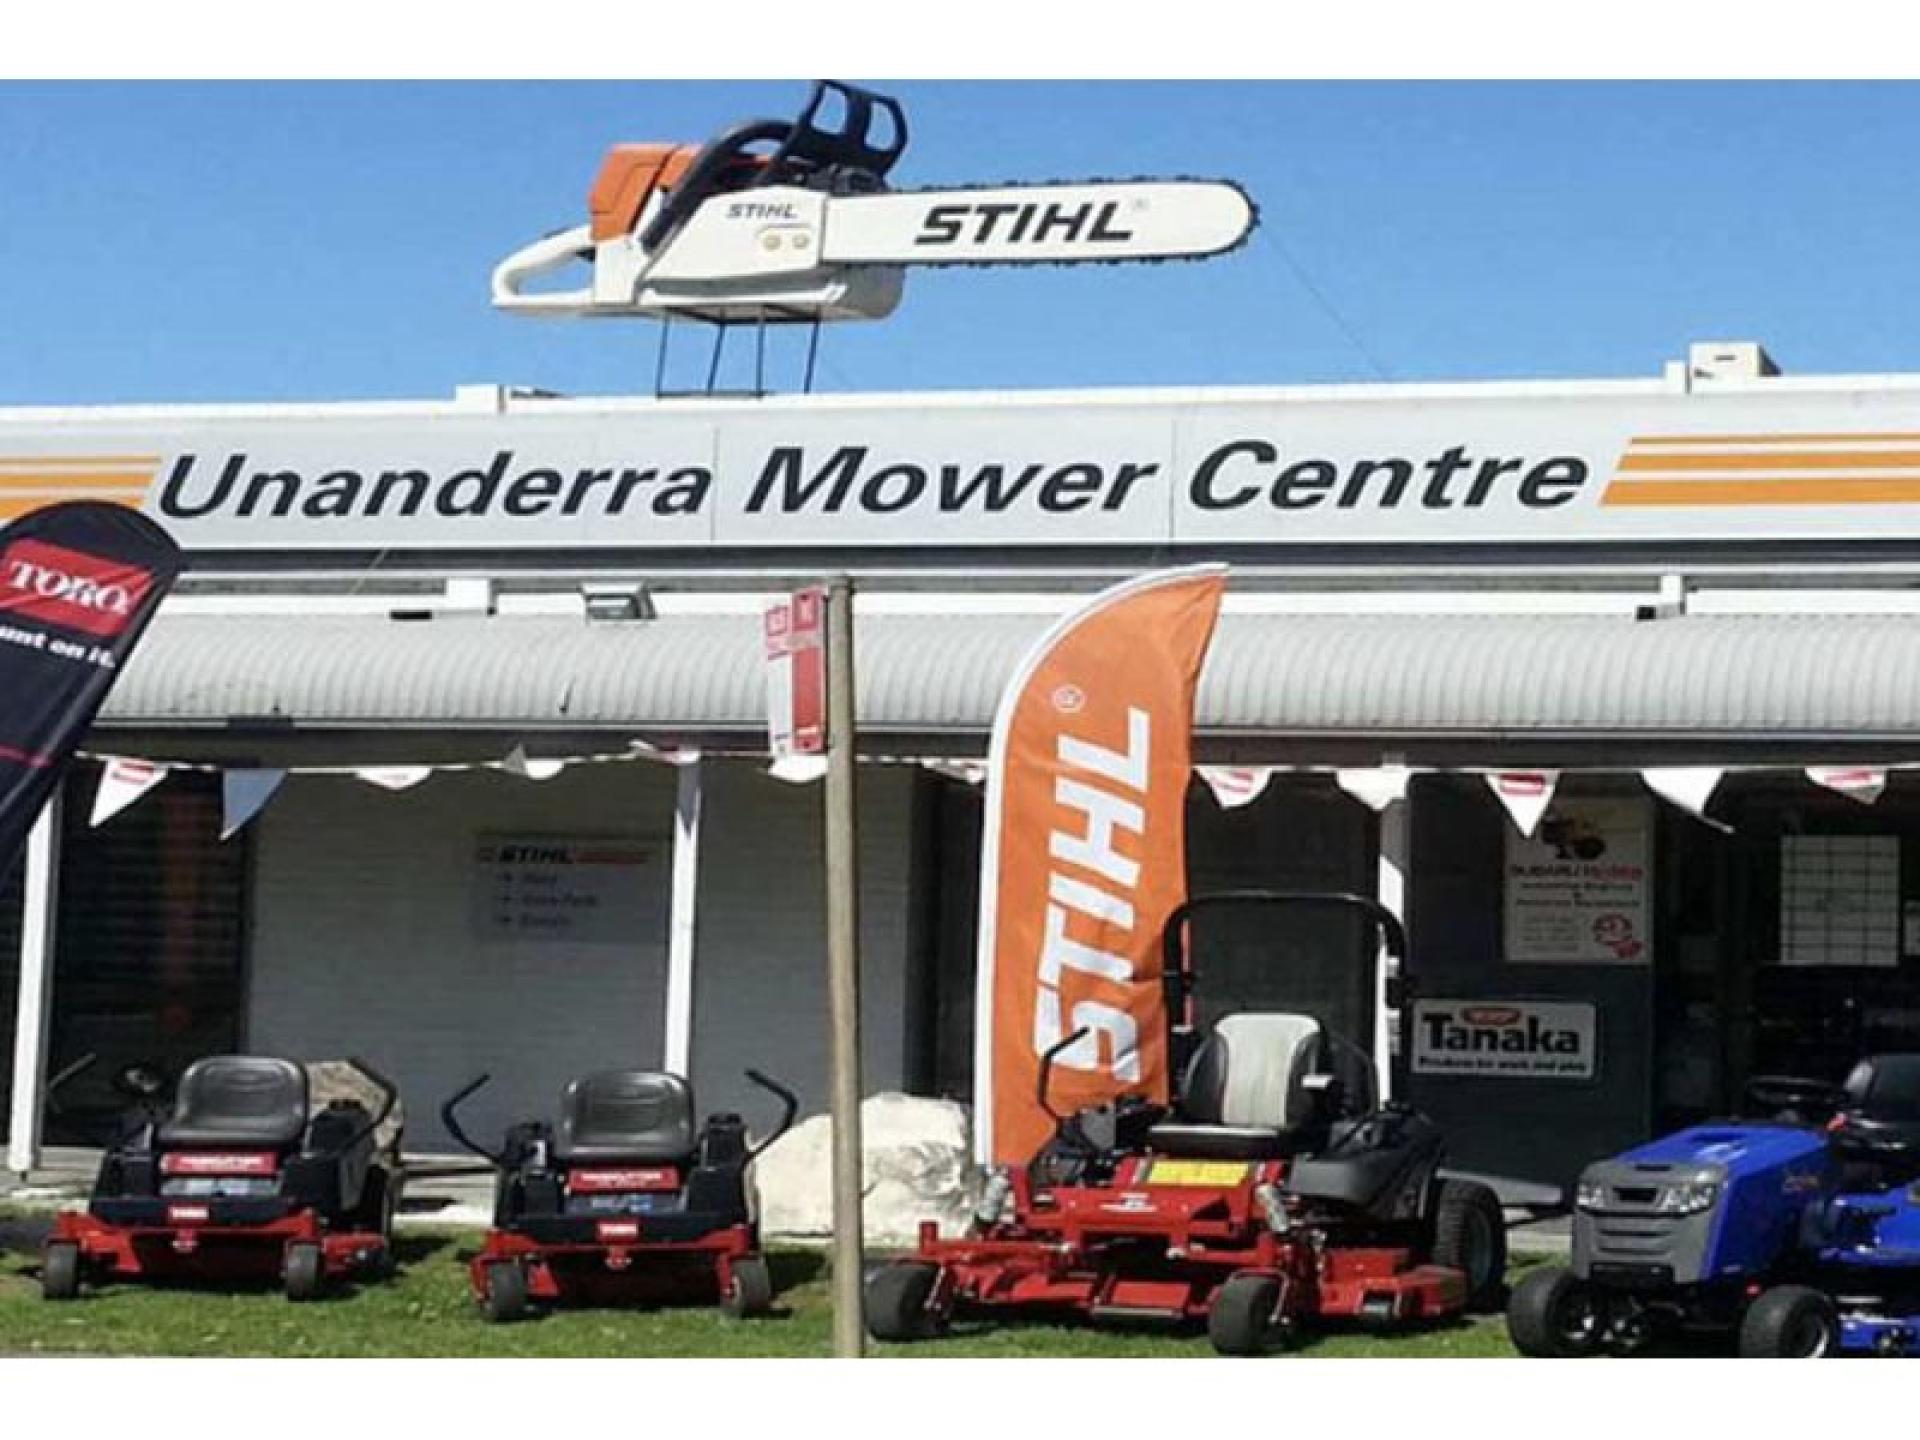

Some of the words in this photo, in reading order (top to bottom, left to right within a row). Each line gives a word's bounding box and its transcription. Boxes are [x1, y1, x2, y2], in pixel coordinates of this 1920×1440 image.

[726, 203, 798, 219] STIHL
[914, 202, 1133, 245] STIHL
[160, 451, 711, 518] Unanderra
[745, 446, 1159, 513] Mower
[1190, 439, 1588, 509] Centre
[9, 560, 129, 615] TORO
[1033, 705, 1151, 1083] STIHL
[1422, 1013, 1580, 1053] Tanaka
